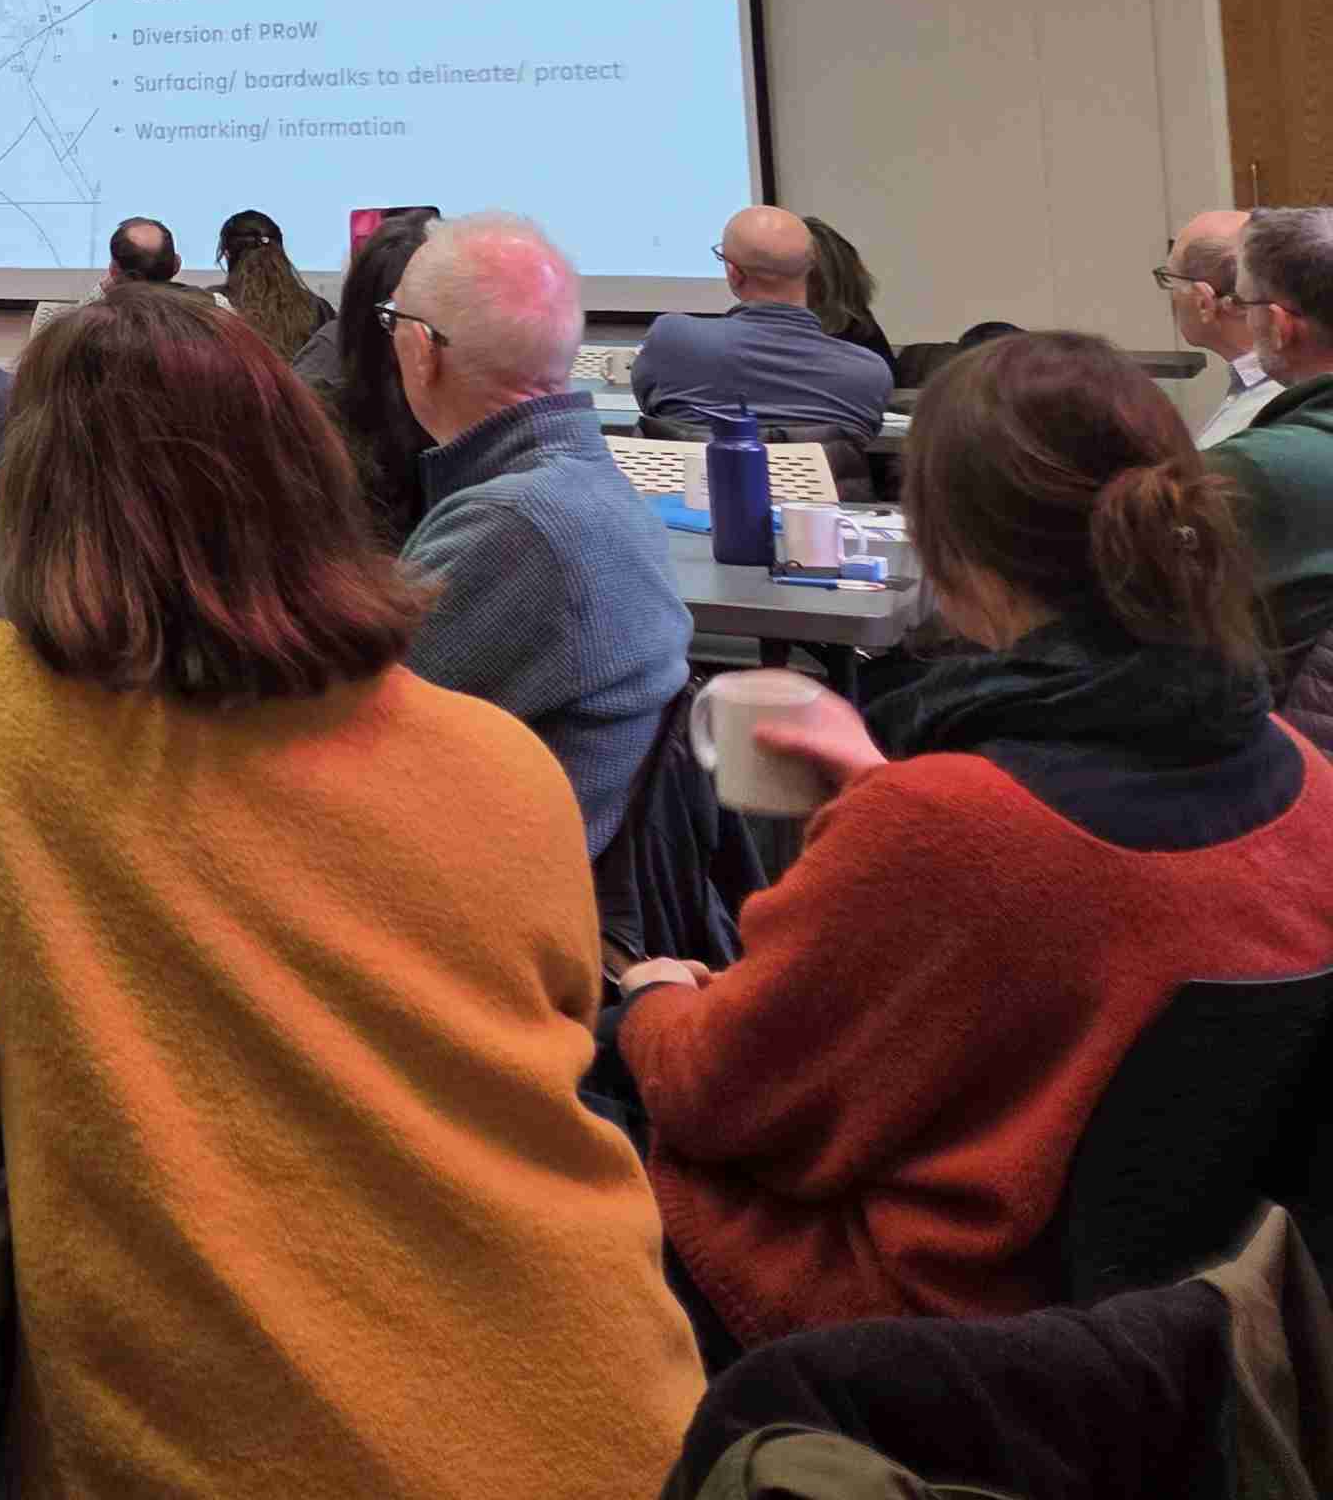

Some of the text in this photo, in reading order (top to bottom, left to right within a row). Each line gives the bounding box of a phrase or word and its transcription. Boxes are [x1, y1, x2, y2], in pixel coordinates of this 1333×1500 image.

[133, 21, 318, 46] Diversion of PRoW
[134, 60, 625, 95] Surfacing/ boardwalks to delineate/ protect
[135, 116, 405, 143] Waymarking/ information
